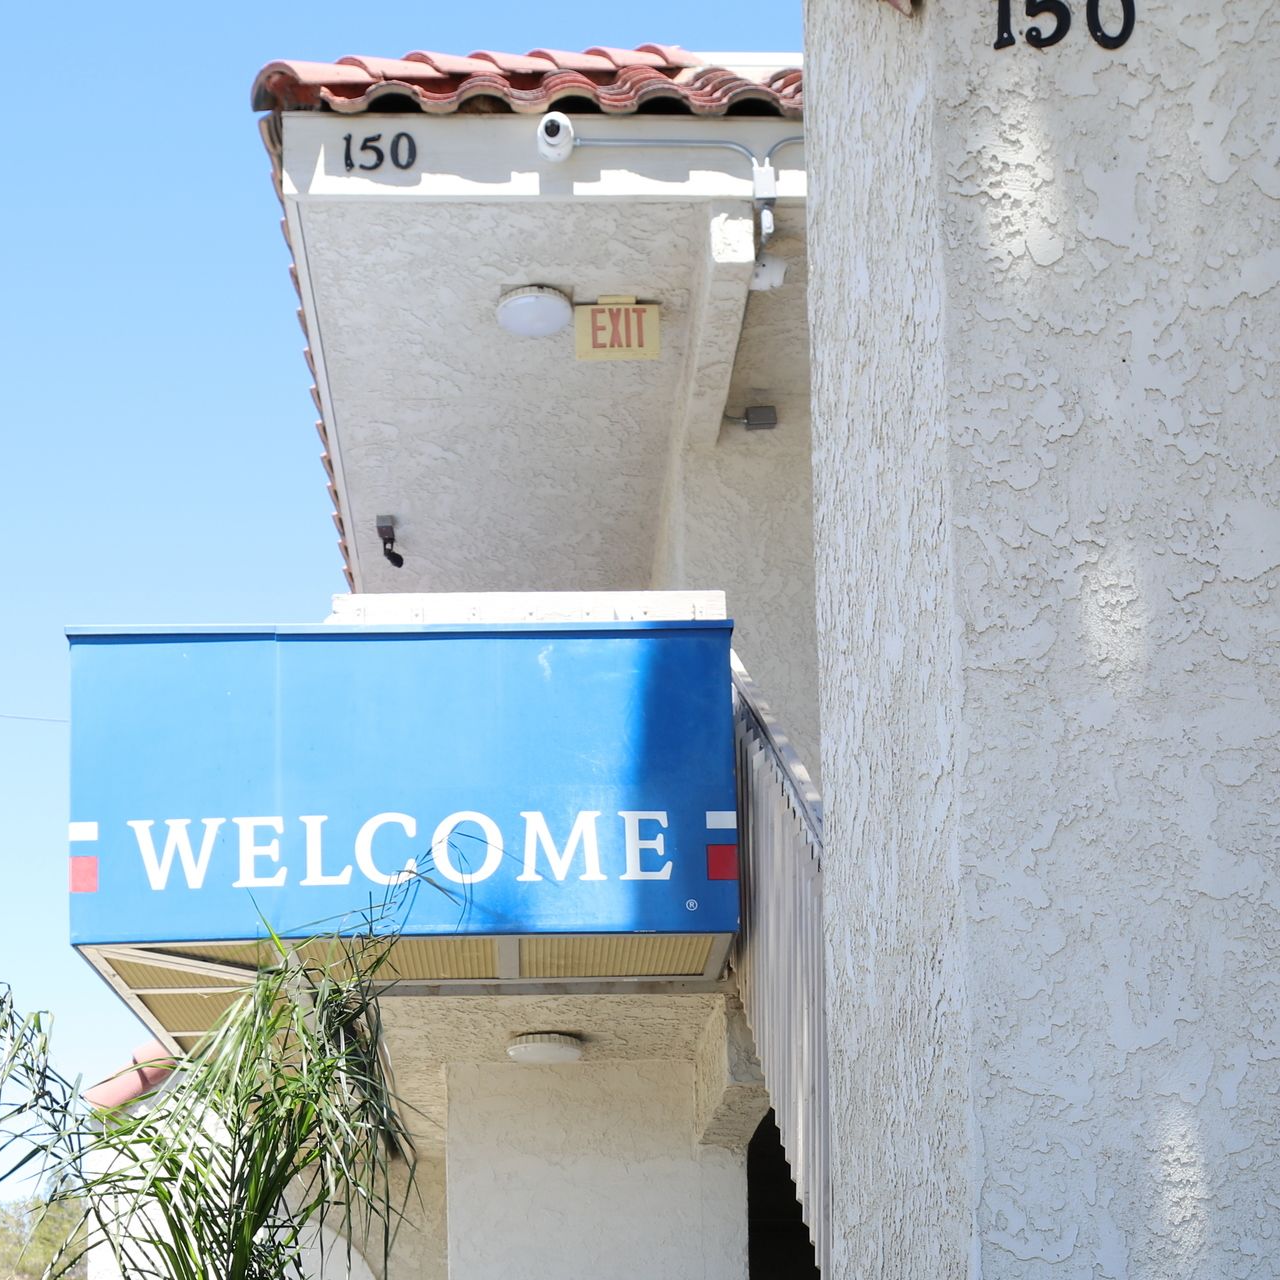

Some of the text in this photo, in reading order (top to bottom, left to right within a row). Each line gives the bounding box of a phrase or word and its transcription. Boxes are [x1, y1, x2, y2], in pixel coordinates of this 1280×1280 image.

[994, 0, 1135, 50] 150
[343, 132, 417, 172] 150
[591, 307, 646, 348] EXIT
[126, 810, 673, 891] WELCOME
